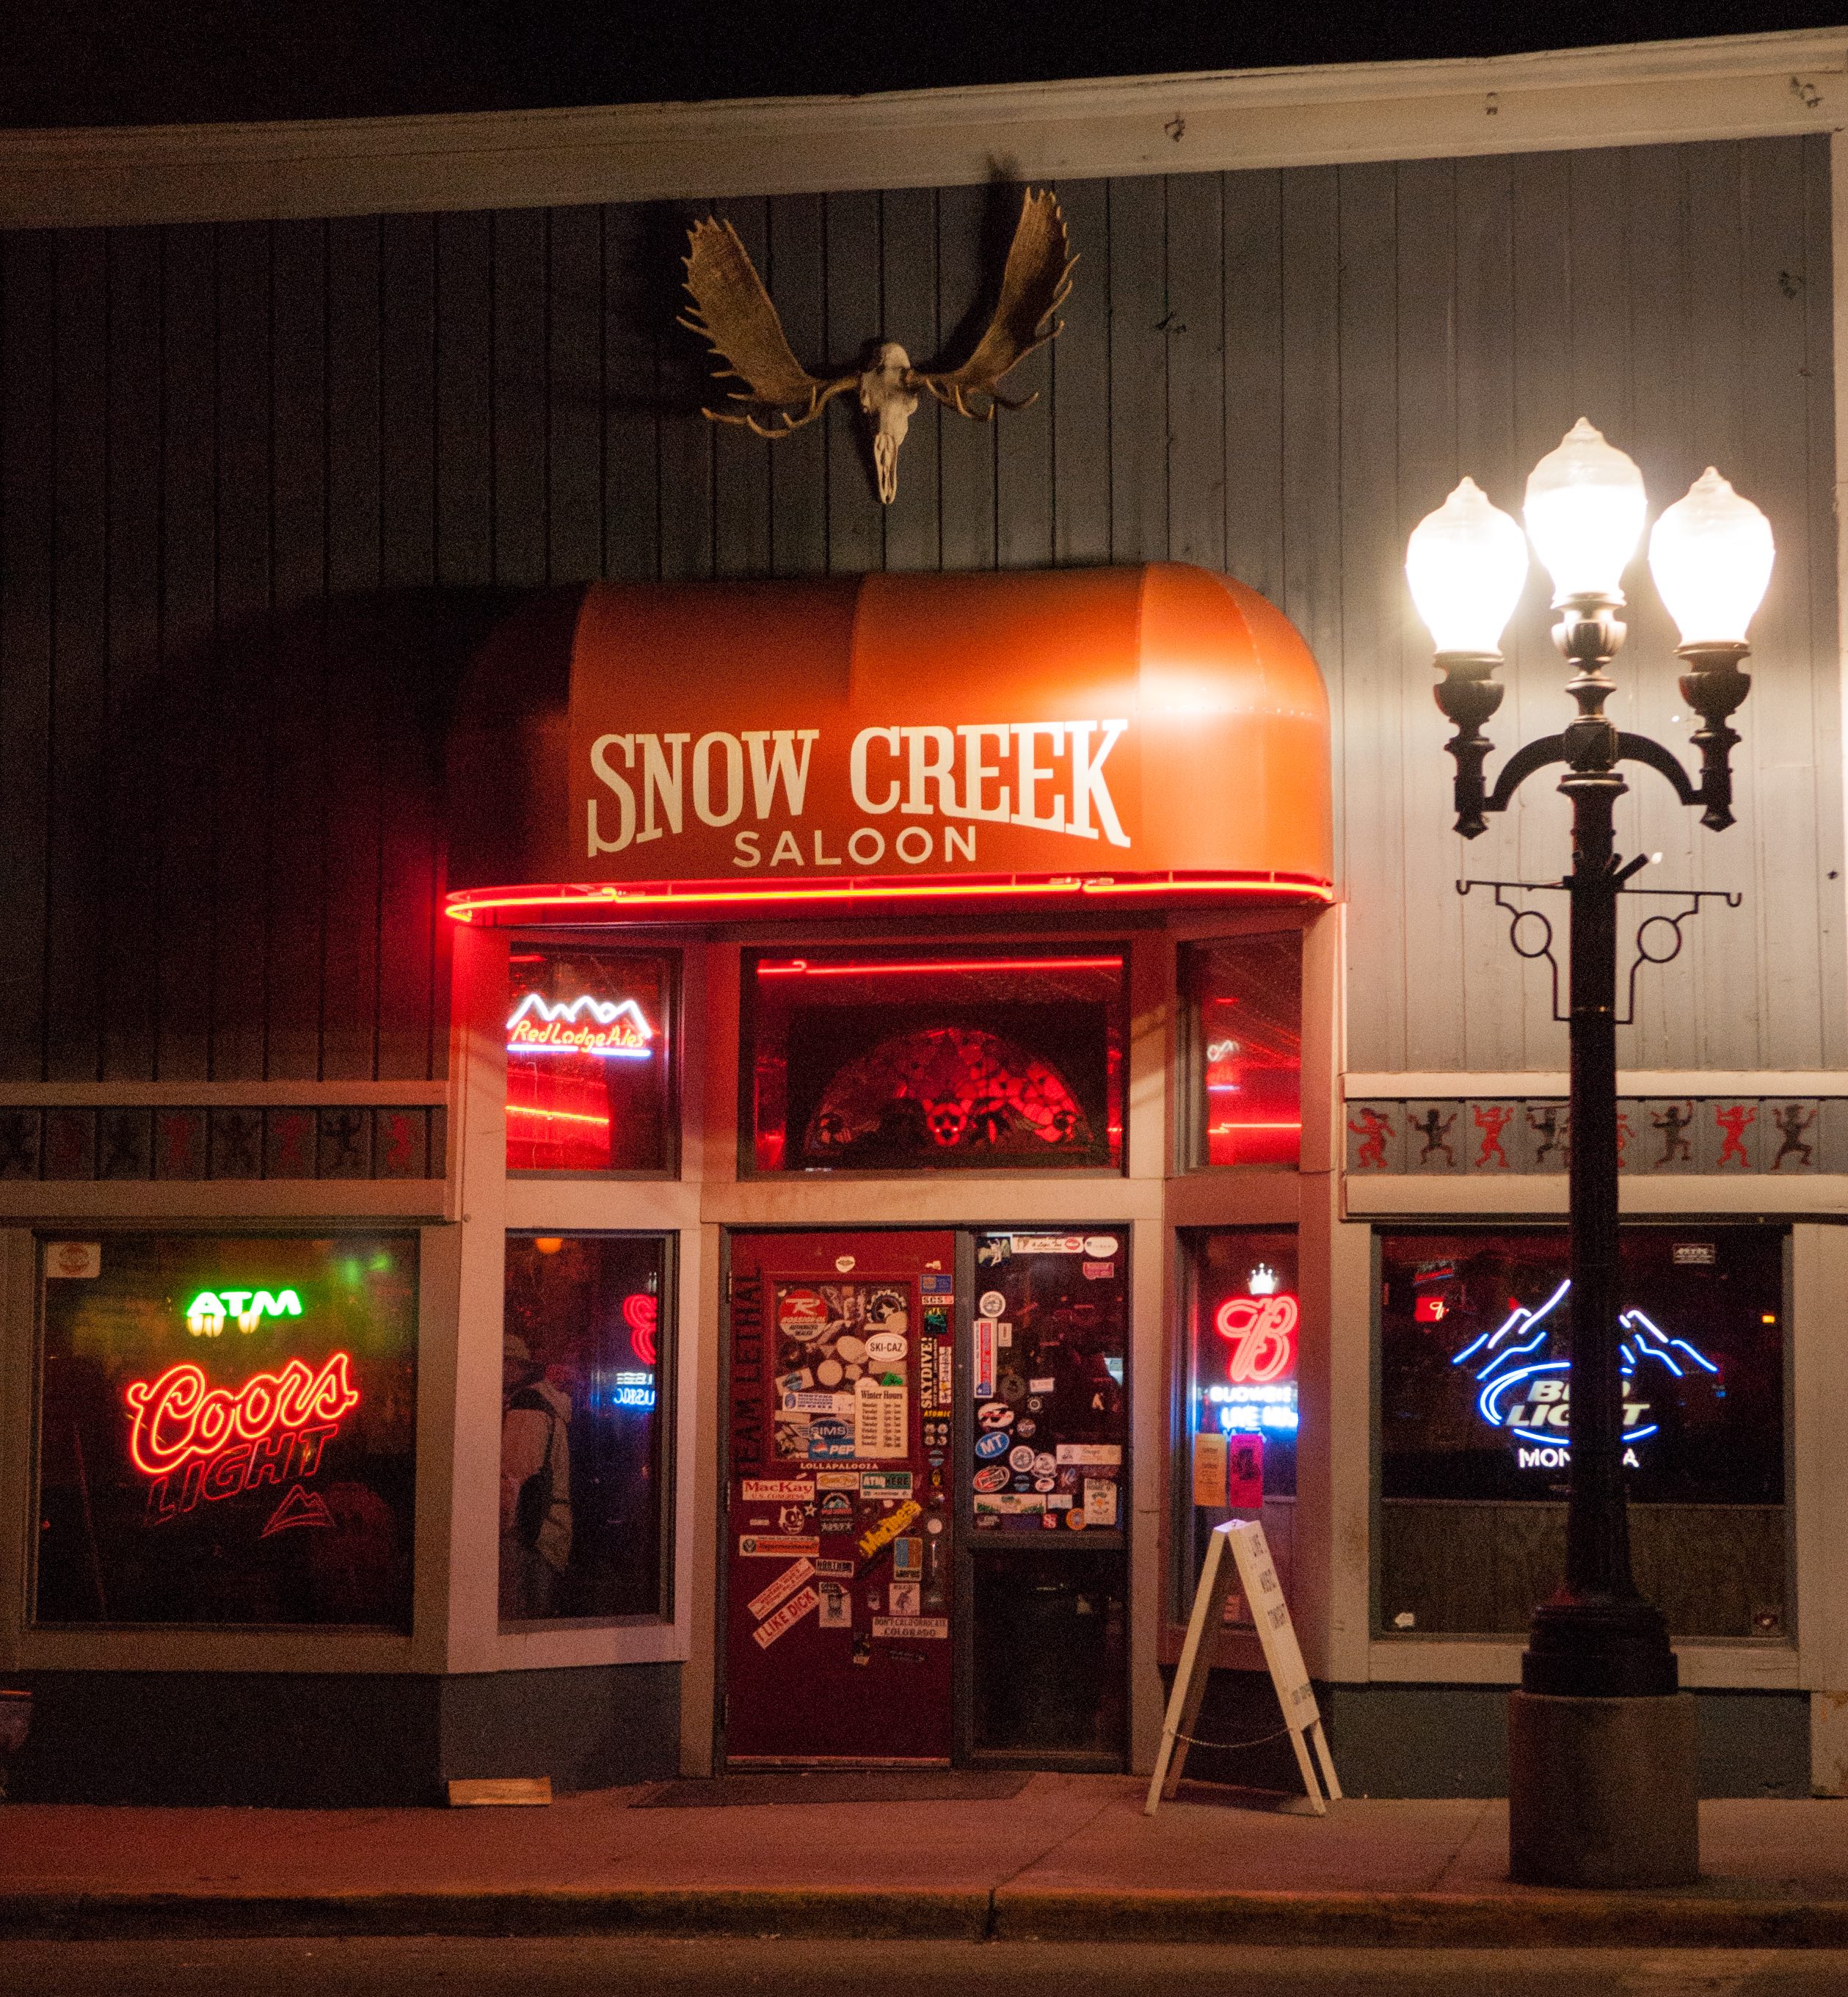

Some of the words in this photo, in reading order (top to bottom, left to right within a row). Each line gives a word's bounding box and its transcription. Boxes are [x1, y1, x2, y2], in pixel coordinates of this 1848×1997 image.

[588, 730, 819, 857] SNOW
[850, 719, 1131, 848] CREEK
[734, 826, 976, 867] SALOON
[512, 1020, 551, 1043] Red
[551, 1023, 605, 1053] Lodge
[606, 1025, 646, 1048] Ales
[186, 1289, 302, 1317] ATM
[734, 1265, 761, 1383] LETHAL
[870, 1342, 903, 1353] SKI-CAZ
[920, 1337, 933, 1408] SKYDIVE!
[861, 1390, 882, 1399] Winter
[884, 1390, 903, 1399] Hours
[128, 1353, 358, 1474] Coors
[923, 1410, 952, 1418] ATOMIC
[1506, 1403, 1651, 1426] LIGT
[734, 1396, 761, 1481] TEAM
[979, 1435, 1003, 1455] MT
[146, 1424, 338, 1526] LIGHT
[744, 1481, 813, 1494] MacKay
[761, 1611, 789, 1637] LIKE
[785, 1590, 815, 1617] DICK
